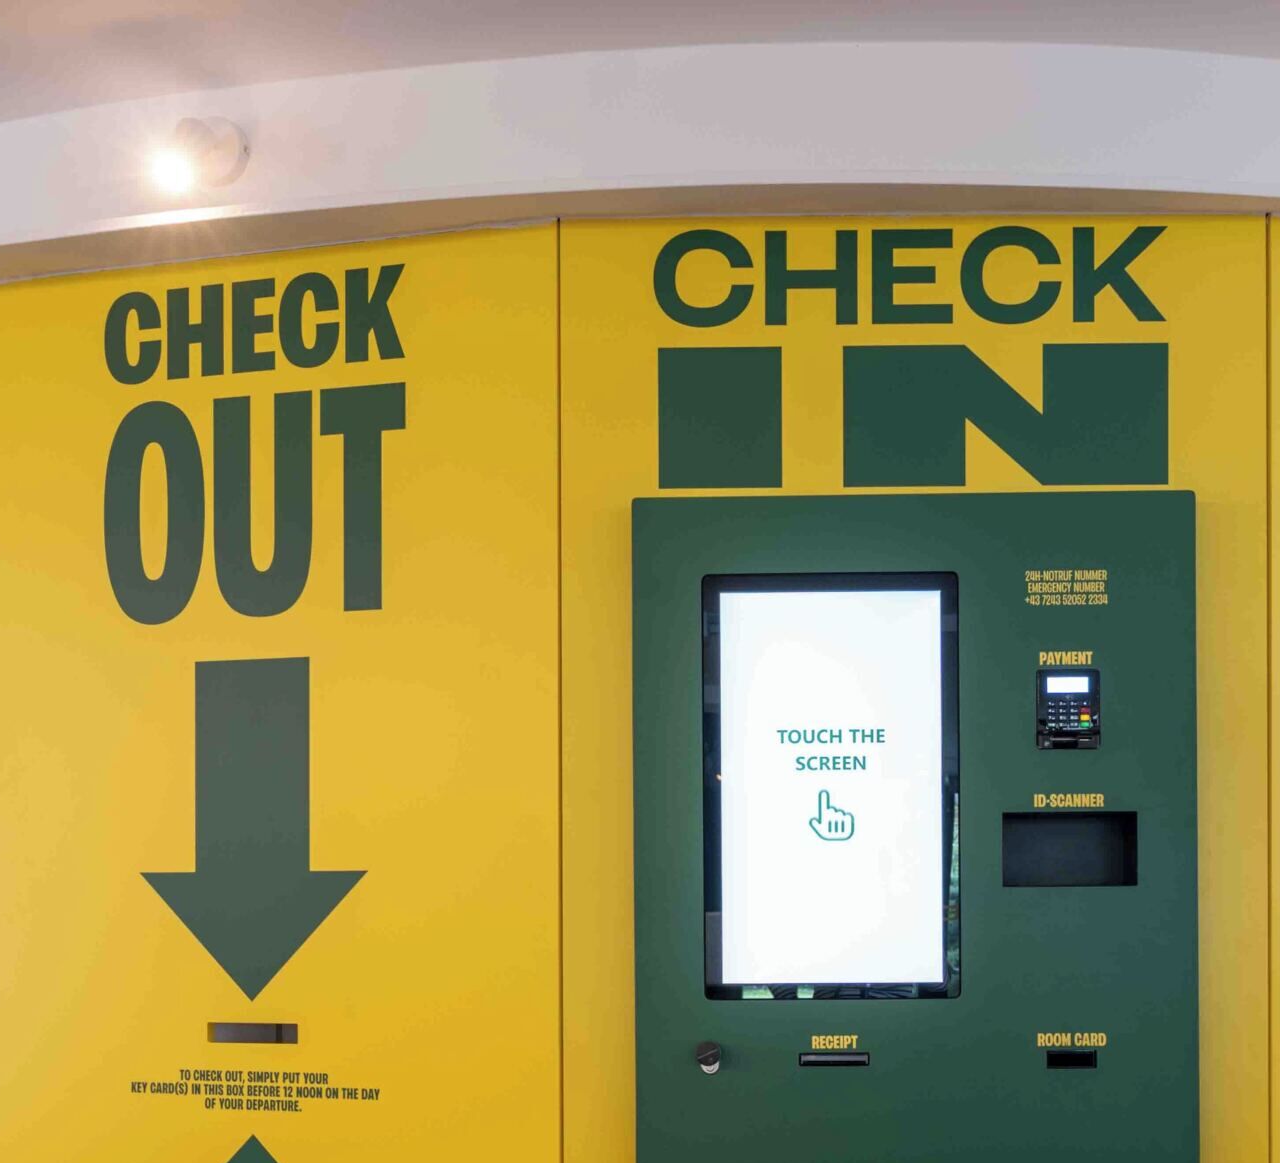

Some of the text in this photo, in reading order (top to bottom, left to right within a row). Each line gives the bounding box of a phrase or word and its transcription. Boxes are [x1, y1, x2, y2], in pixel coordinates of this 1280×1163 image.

[653, 226, 1168, 327] CHECK
[104, 264, 405, 384] CHECK
[658, 343, 1168, 489] IN
[104, 382, 406, 624] OUT
[1039, 651, 1093, 665] PAYMENT
[776, 728, 886, 745] TOUCH THE
[795, 755, 868, 771] SCREEN
[1033, 794, 1105, 808] ID-SCANNER
[811, 1035, 859, 1050] RECEIPT
[1037, 1032, 1107, 1047] ROOM CARD
[180, 1069, 329, 1085] TO CHECK OUT, SIMPLY PUT YOUR
[131, 1082, 381, 1101] KEY CARD(S) IN THIS BOX BEFORE 12 NOON ON THE DAY
[205, 1098, 303, 1112] OF YOUR DEPARTURE.
